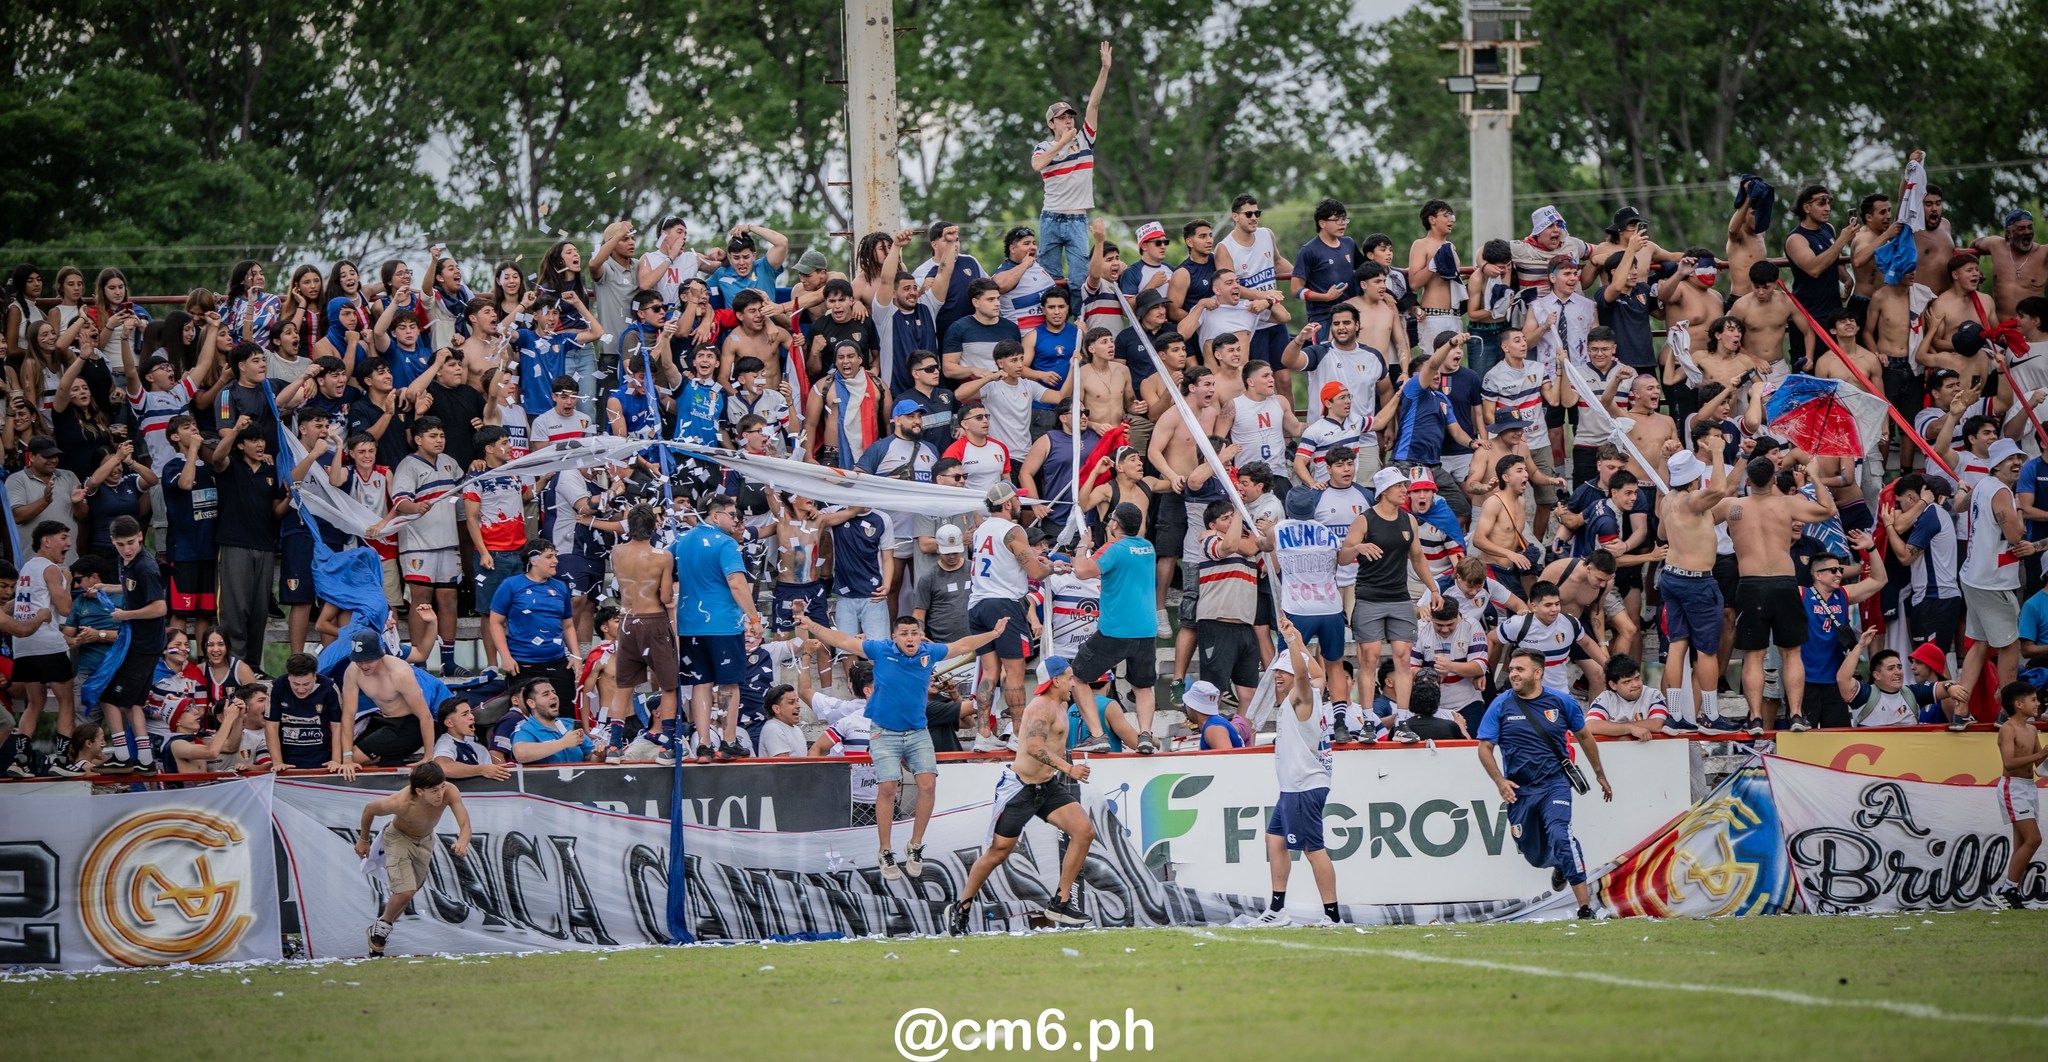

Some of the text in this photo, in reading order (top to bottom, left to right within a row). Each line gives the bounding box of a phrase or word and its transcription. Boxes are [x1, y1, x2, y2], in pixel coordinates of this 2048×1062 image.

[667, 268, 679, 284] N
[1258, 412, 1271, 428] N
[1260, 444, 1271, 461] G
[979, 536, 994, 556] A
[1278, 524, 1338, 549] NUNCA
[980, 558, 992, 578] 2
[1823, 618, 1832, 633] 4
[1857, 782, 1931, 836] A
[1223, 799, 1522, 864] FGRO
